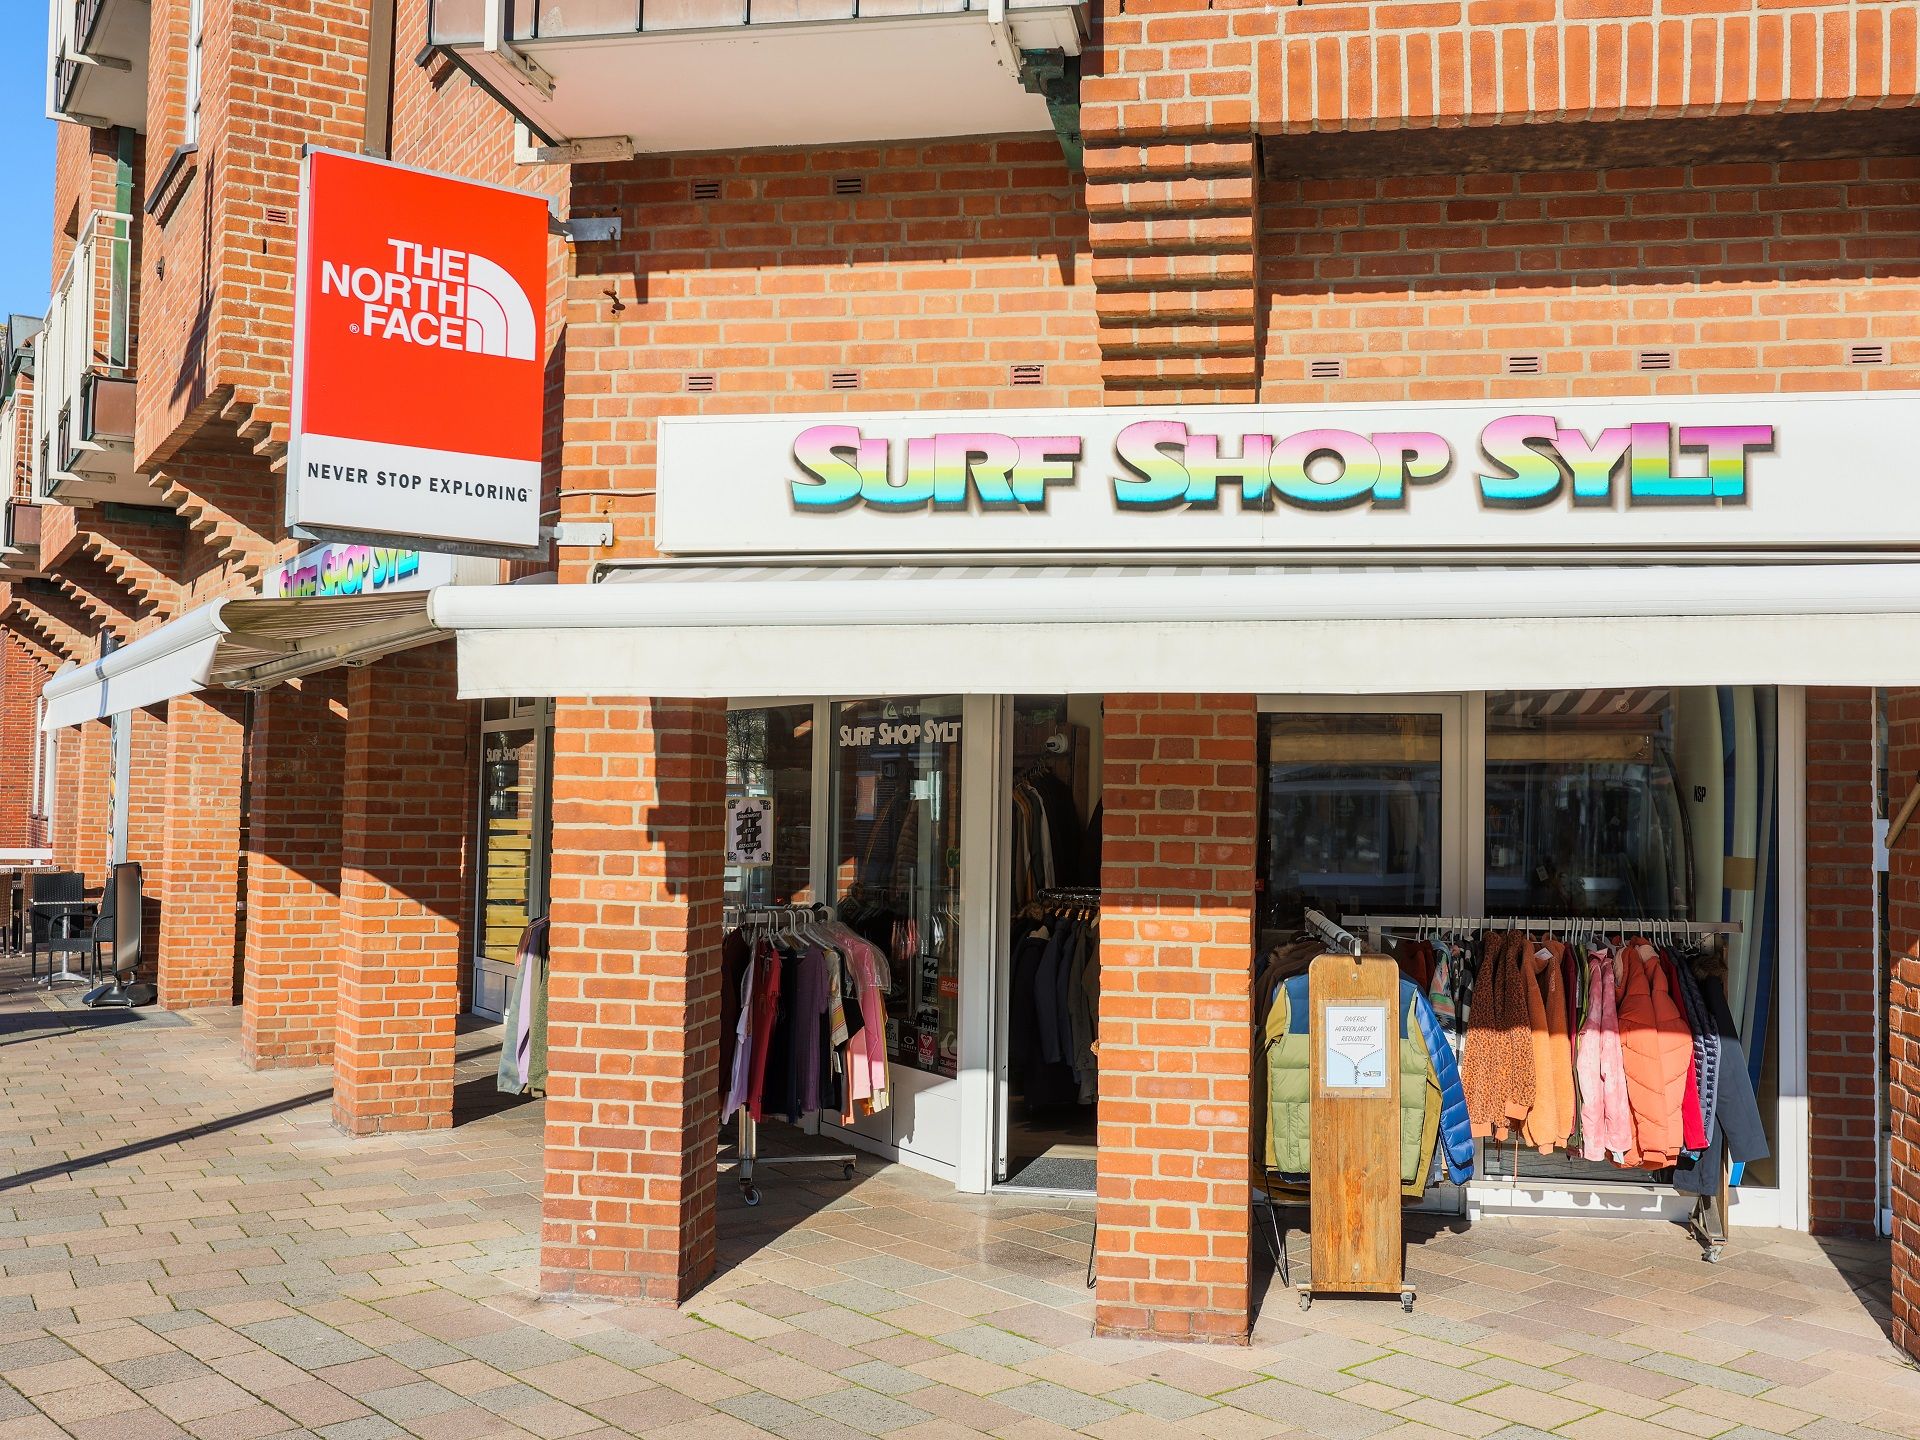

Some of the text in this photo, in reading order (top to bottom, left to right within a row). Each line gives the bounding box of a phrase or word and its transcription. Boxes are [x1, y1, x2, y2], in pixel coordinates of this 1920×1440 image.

[388, 238, 465, 284] THE
[321, 260, 464, 317] NORTH
[364, 303, 463, 351] FACE
[307, 461, 369, 484] NEVER
[376, 471, 422, 490] STOP
[792, 414, 1773, 509] SURF SHOP SYLT
[320, 545, 370, 596] SHOP
[840, 719, 961, 747] SURF SHOP SYLT
[1694, 785, 1706, 802] NSP
